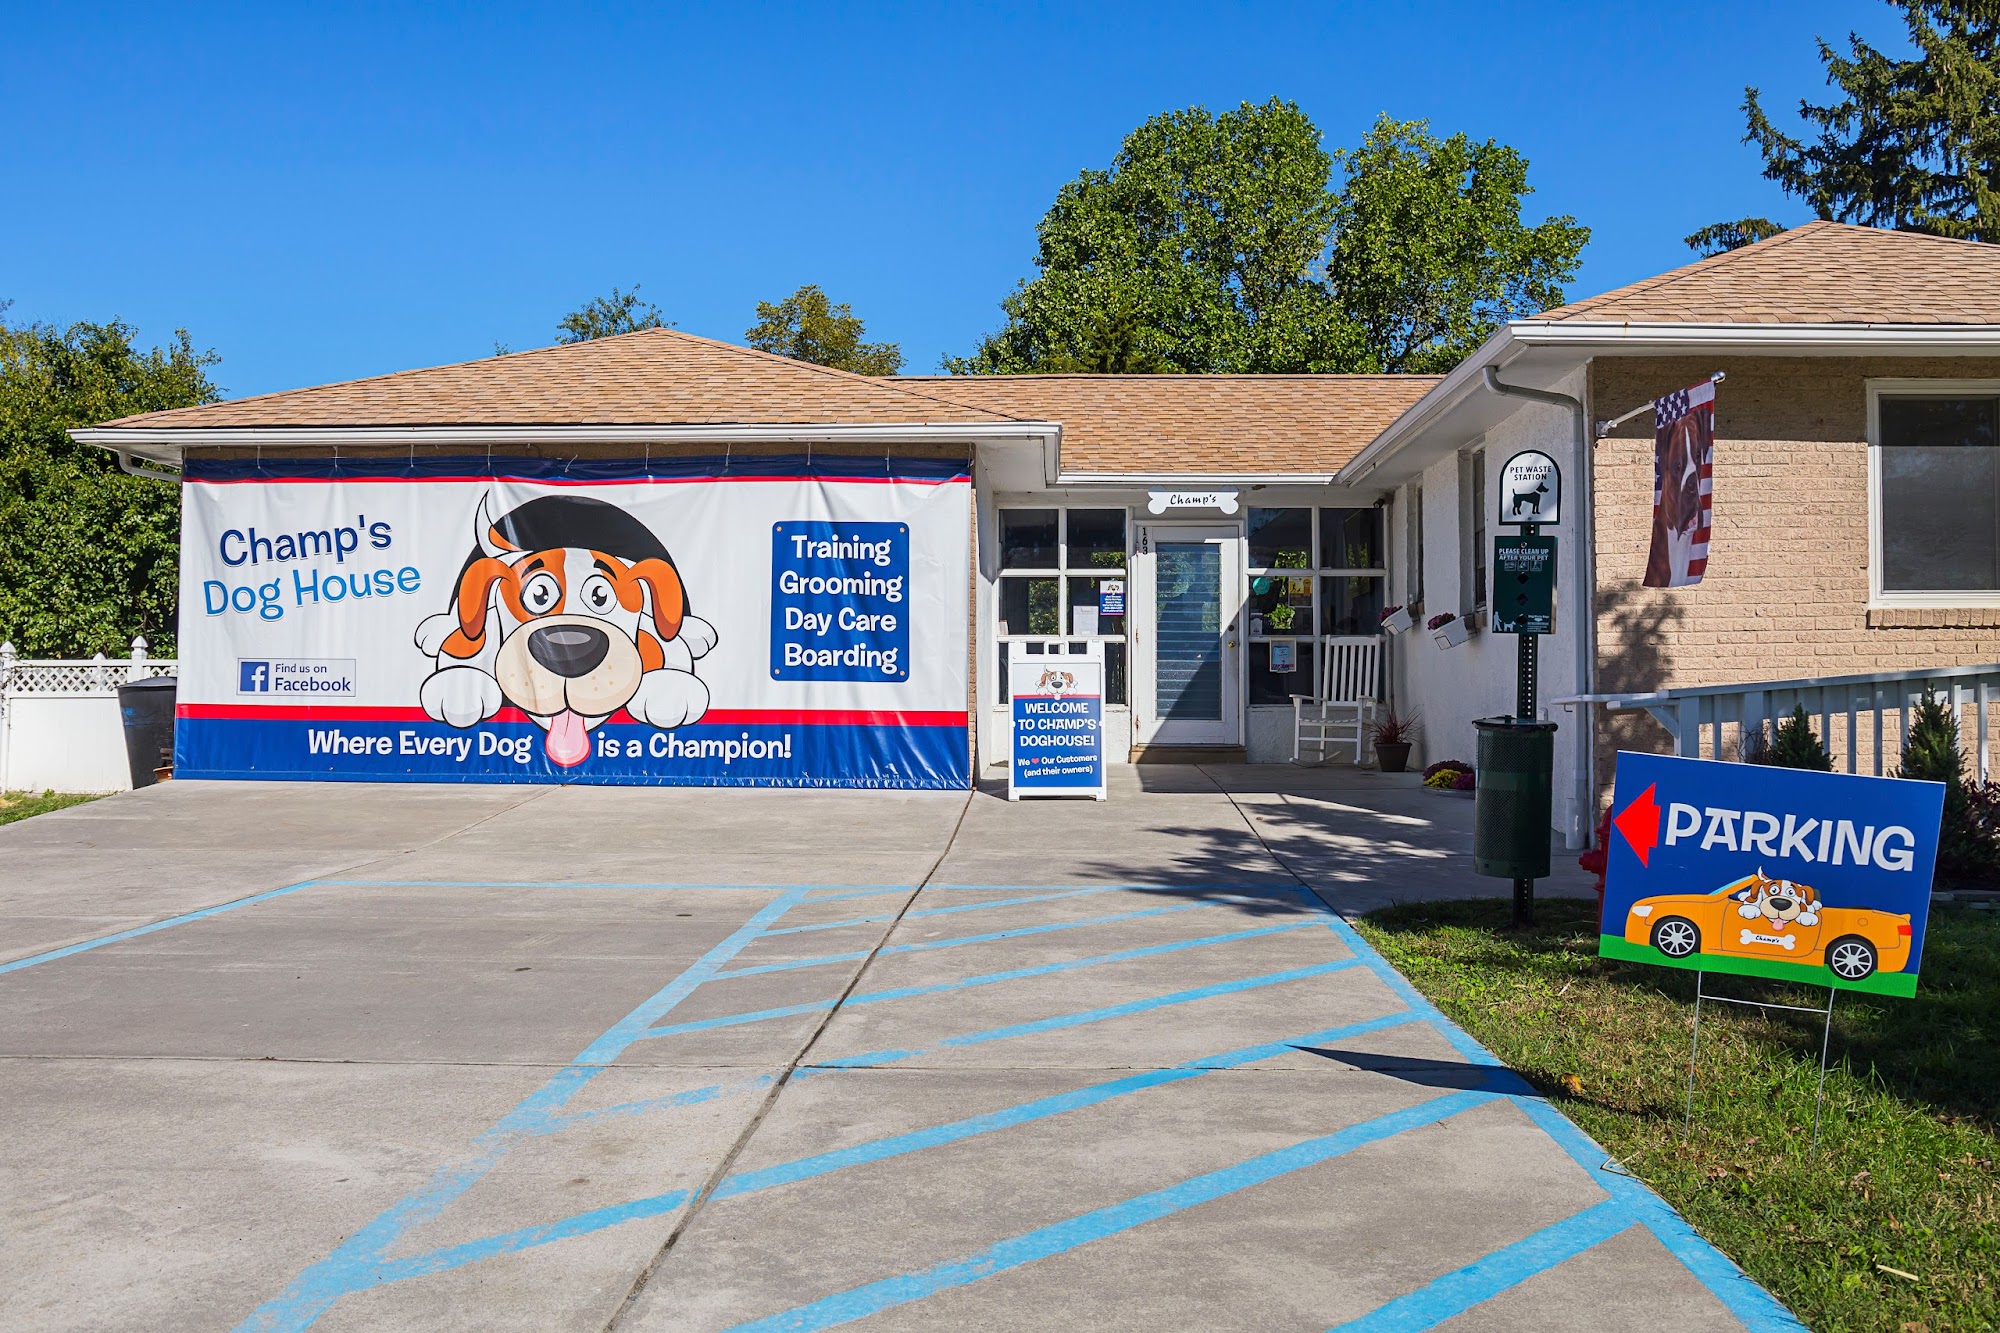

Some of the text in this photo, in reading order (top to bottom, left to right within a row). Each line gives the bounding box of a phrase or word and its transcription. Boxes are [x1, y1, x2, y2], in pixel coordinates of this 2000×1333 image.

[1514, 473, 1547, 481] STATION
[1170, 494, 1216, 505] Champ's
[220, 514, 392, 566] Champ's
[791, 534, 891, 566] Training
[203, 566, 421, 621] Dog House
[779, 570, 903, 603] Grooming
[785, 606, 897, 636] Day Care
[784, 642, 898, 675] Boarding
[275, 663, 327, 673] Find us on
[275, 676, 351, 692] Facebook
[1024, 702, 1089, 714] WELCOME
[1018, 718, 1096, 730] TO CHAMP'S
[308, 728, 792, 765] Where Every Dog is a Champion!
[1020, 735, 1095, 747] DOGHOUSE!
[1041, 756, 1055, 765] Our
[1056, 754, 1098, 764] Customers
[1024, 764, 1093, 778] (and their owners)
[1665, 802, 1916, 872] PARKING
[1755, 935, 1780, 944] Champ's
